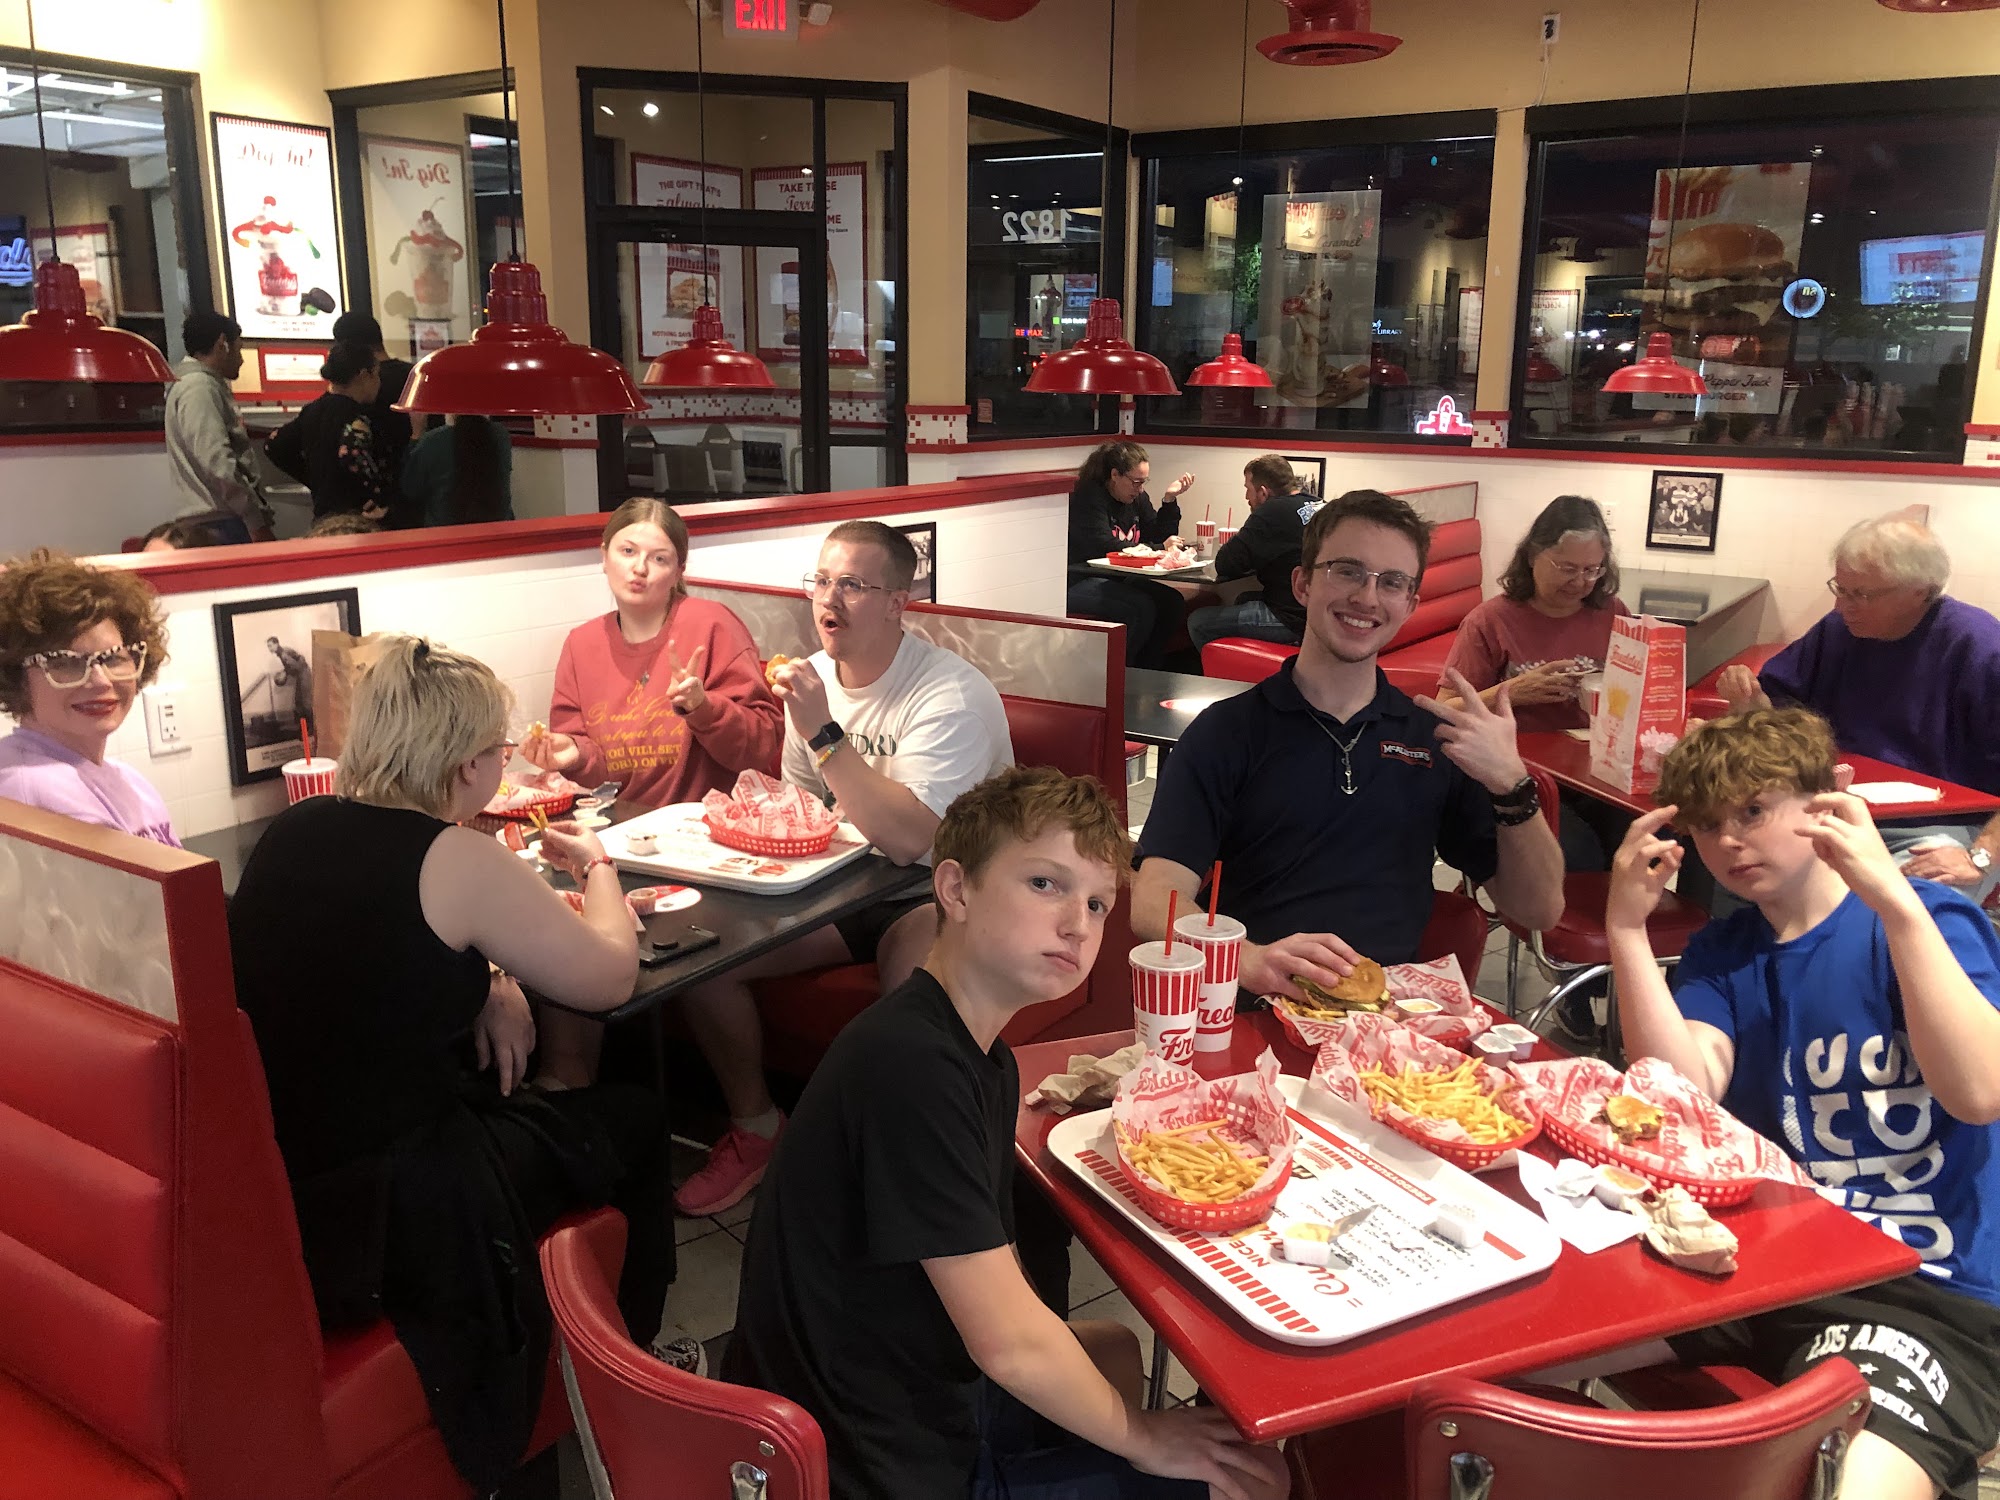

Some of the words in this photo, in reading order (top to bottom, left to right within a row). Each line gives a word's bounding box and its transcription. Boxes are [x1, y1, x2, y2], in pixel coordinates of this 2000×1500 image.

[778, 183, 804, 193] TAKE
[1340, 1145, 1433, 1201] FREDDYSUSA.COM
[1226, 1239, 1272, 1268] NICE
[1805, 1323, 1850, 1362] LOS
[1850, 1323, 1950, 1405] ANGELES
